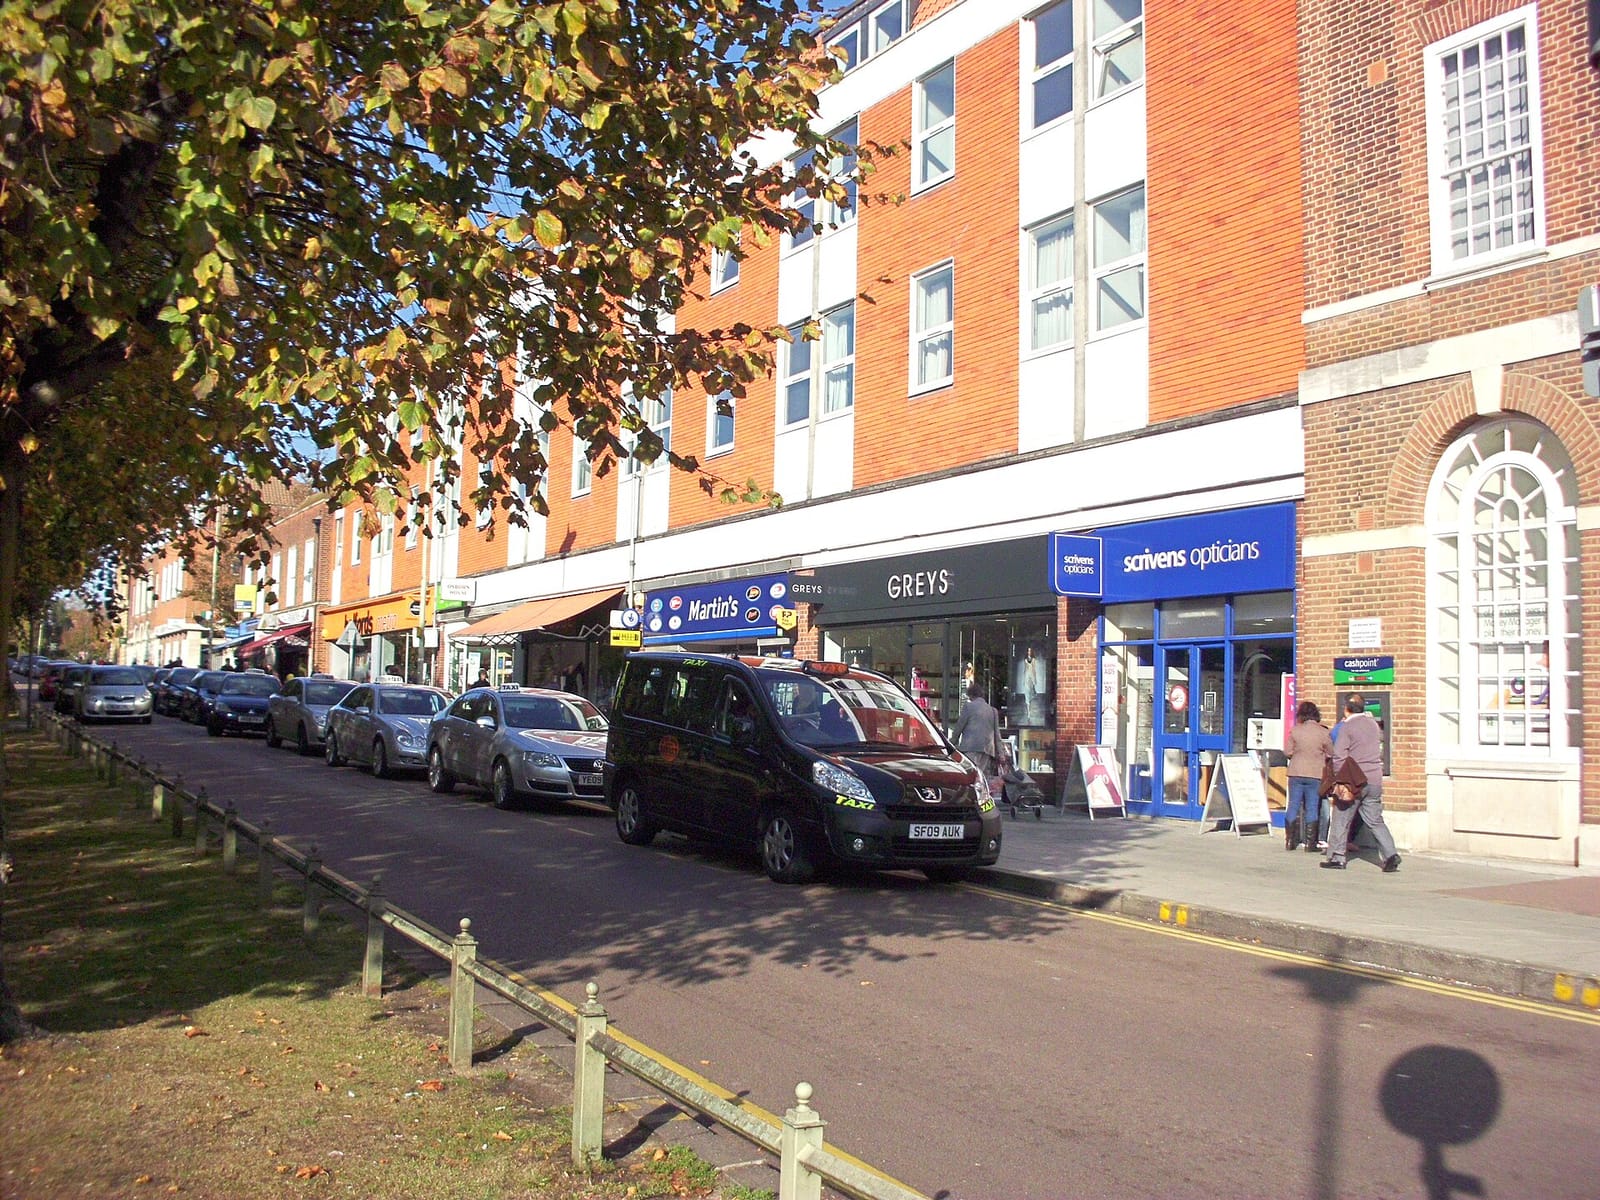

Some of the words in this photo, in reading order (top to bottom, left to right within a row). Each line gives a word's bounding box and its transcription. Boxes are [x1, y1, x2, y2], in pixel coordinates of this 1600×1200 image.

[1063, 553, 1094, 566] scrivens
[1123, 548, 1186, 573] scrivens
[1190, 539, 1259, 570] opticians
[1063, 563, 1094, 575] opticians
[791, 584, 823, 594] GREYS
[887, 568, 949, 599] GREYS
[688, 595, 739, 621] Martin's
[344, 610, 374, 634] hlfords
[682, 659, 709, 668] TAXI
[1344, 657, 1378, 669] cashpoint
[835, 794, 874, 811] TAXI
[914, 826, 940, 837] SF09
[942, 826, 961, 837] AUK
